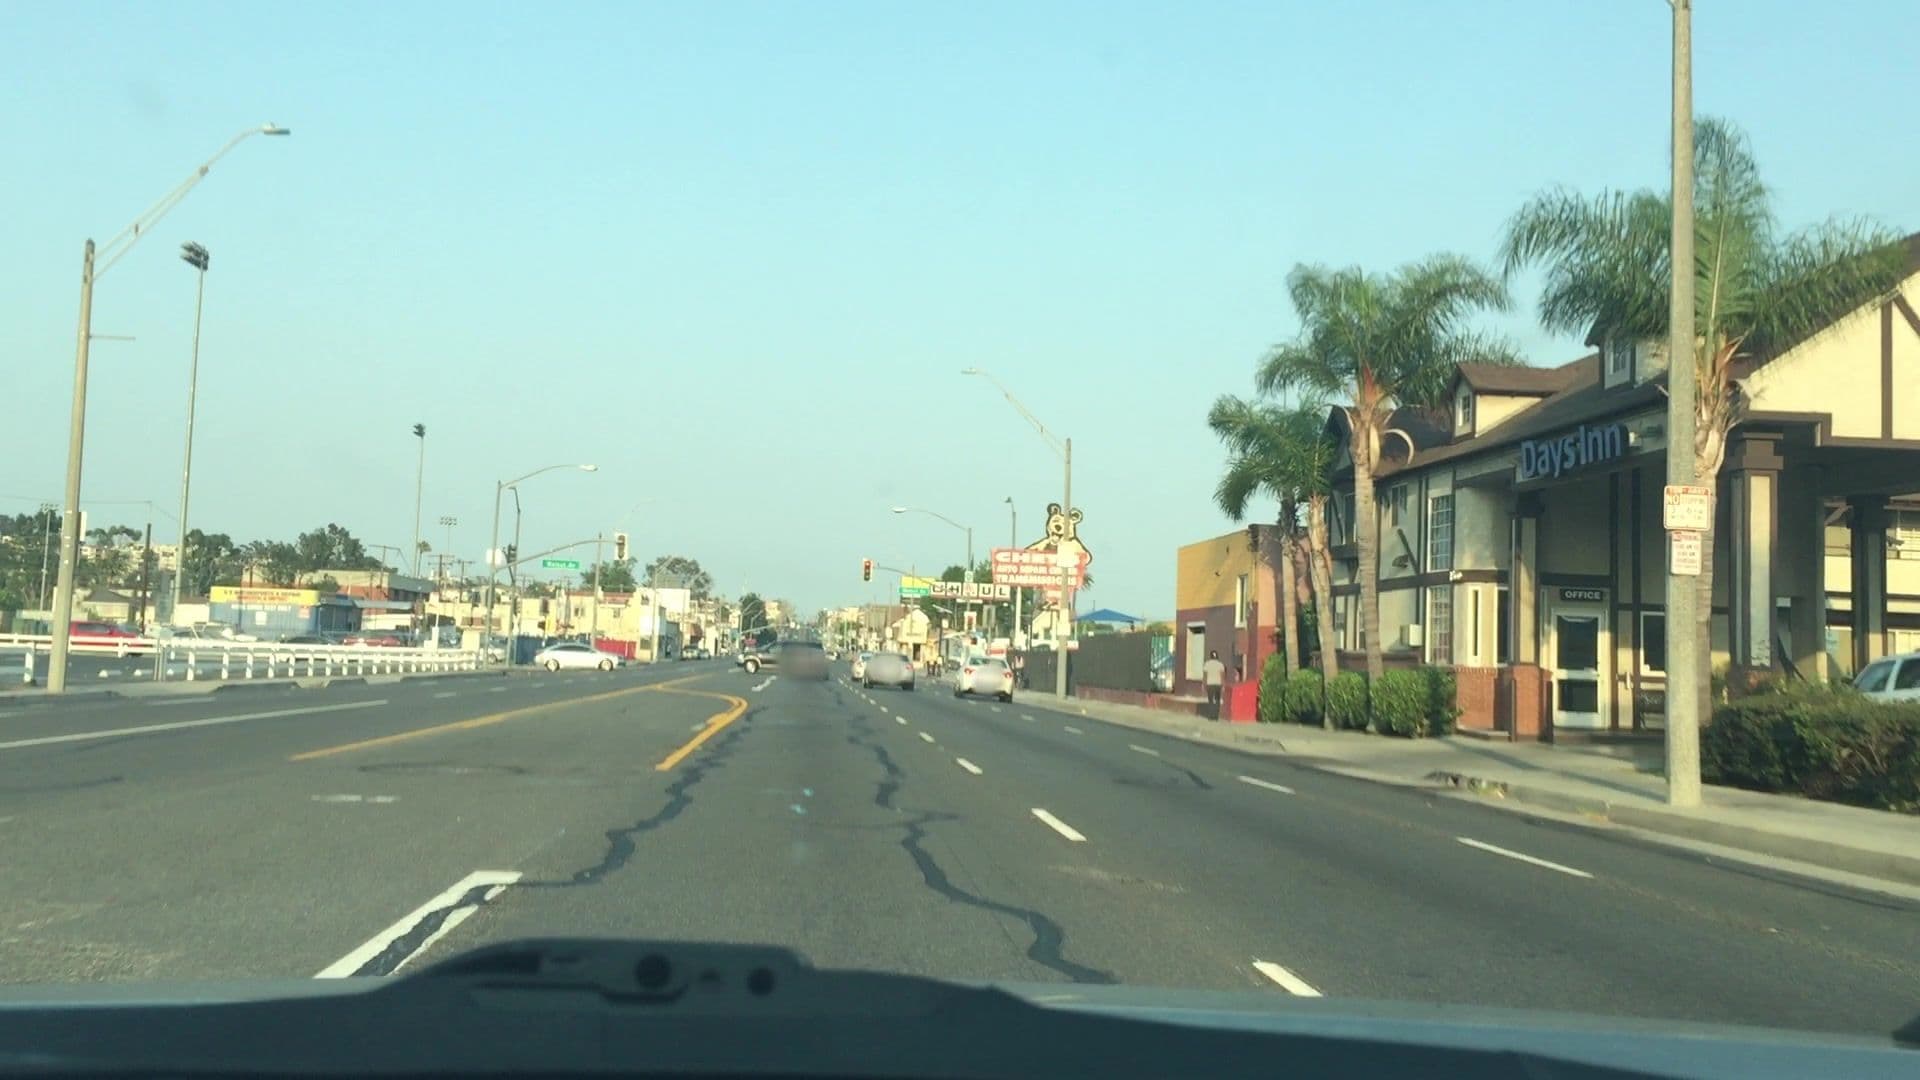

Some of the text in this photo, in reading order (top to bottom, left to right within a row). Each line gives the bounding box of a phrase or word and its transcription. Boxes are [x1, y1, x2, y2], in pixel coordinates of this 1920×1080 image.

[1520, 424, 1621, 478] Days Inn
[994, 573, 1077, 585] TRANSMISSIOS
[1564, 590, 1601, 600] OFFICE
